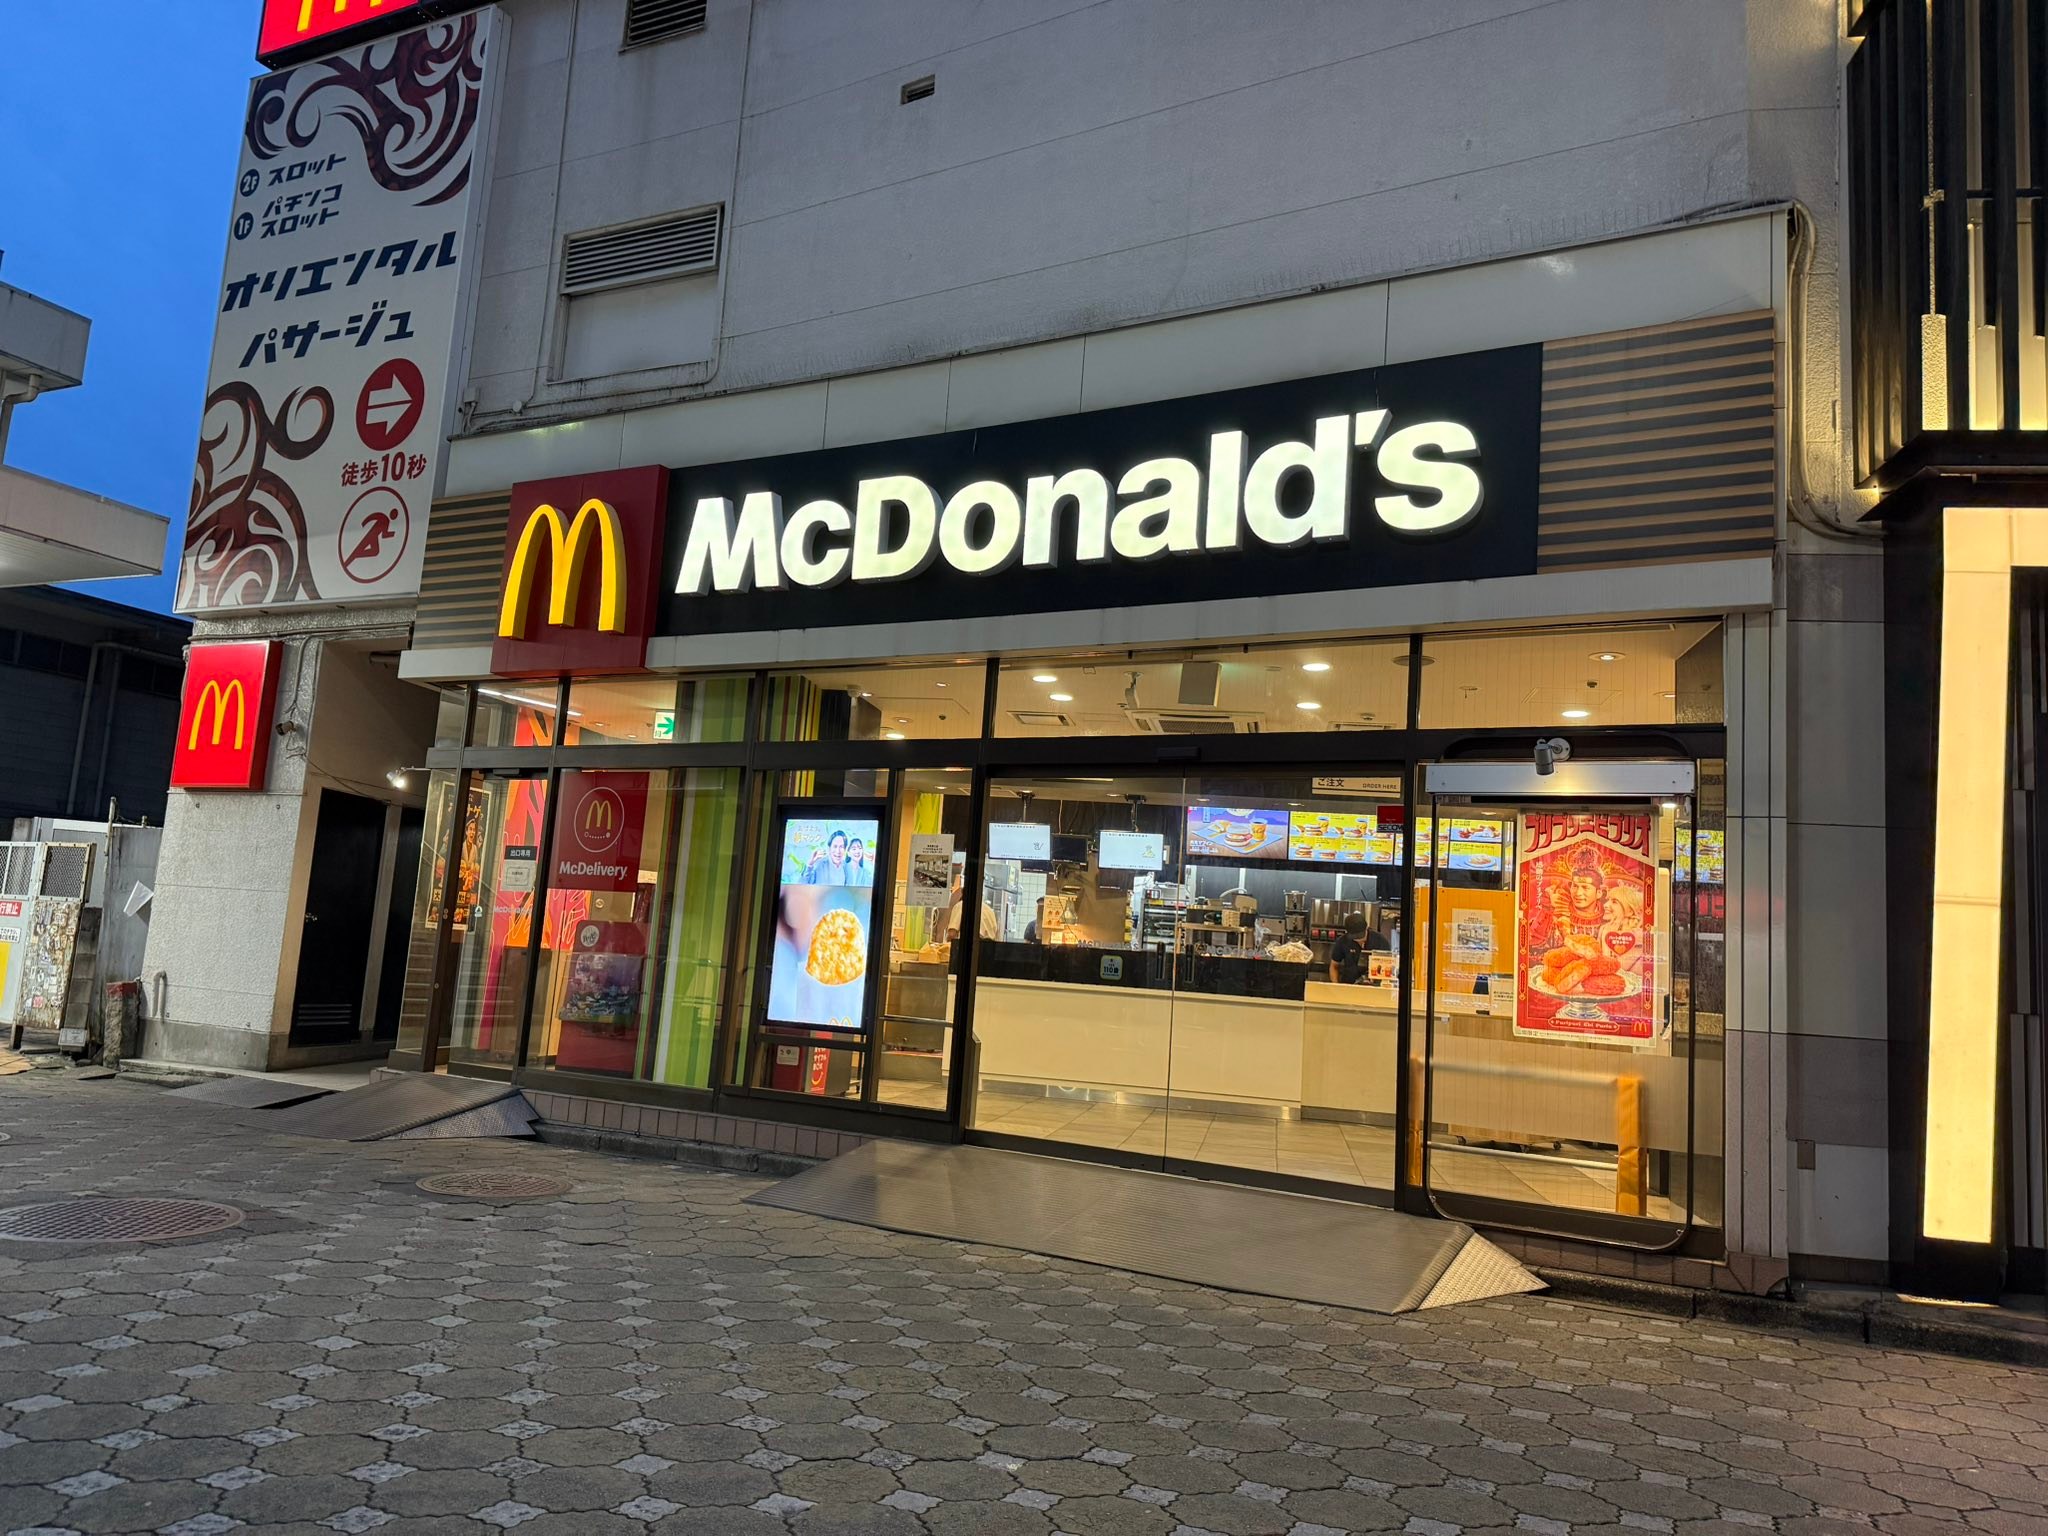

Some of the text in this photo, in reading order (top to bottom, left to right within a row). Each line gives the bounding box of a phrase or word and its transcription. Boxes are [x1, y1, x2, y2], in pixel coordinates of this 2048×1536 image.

[242, 154, 346, 193] 2F スロット
[262, 184, 342, 218] パチンコ
[238, 208, 339, 239] 1F スロット
[222, 231, 456, 312] オリエンタル
[239, 300, 414, 368] パサージュ
[341, 452, 427, 487] 徒歩10秒
[675, 408, 1484, 596] McDonald's
[559, 861, 628, 881] McDelivery
